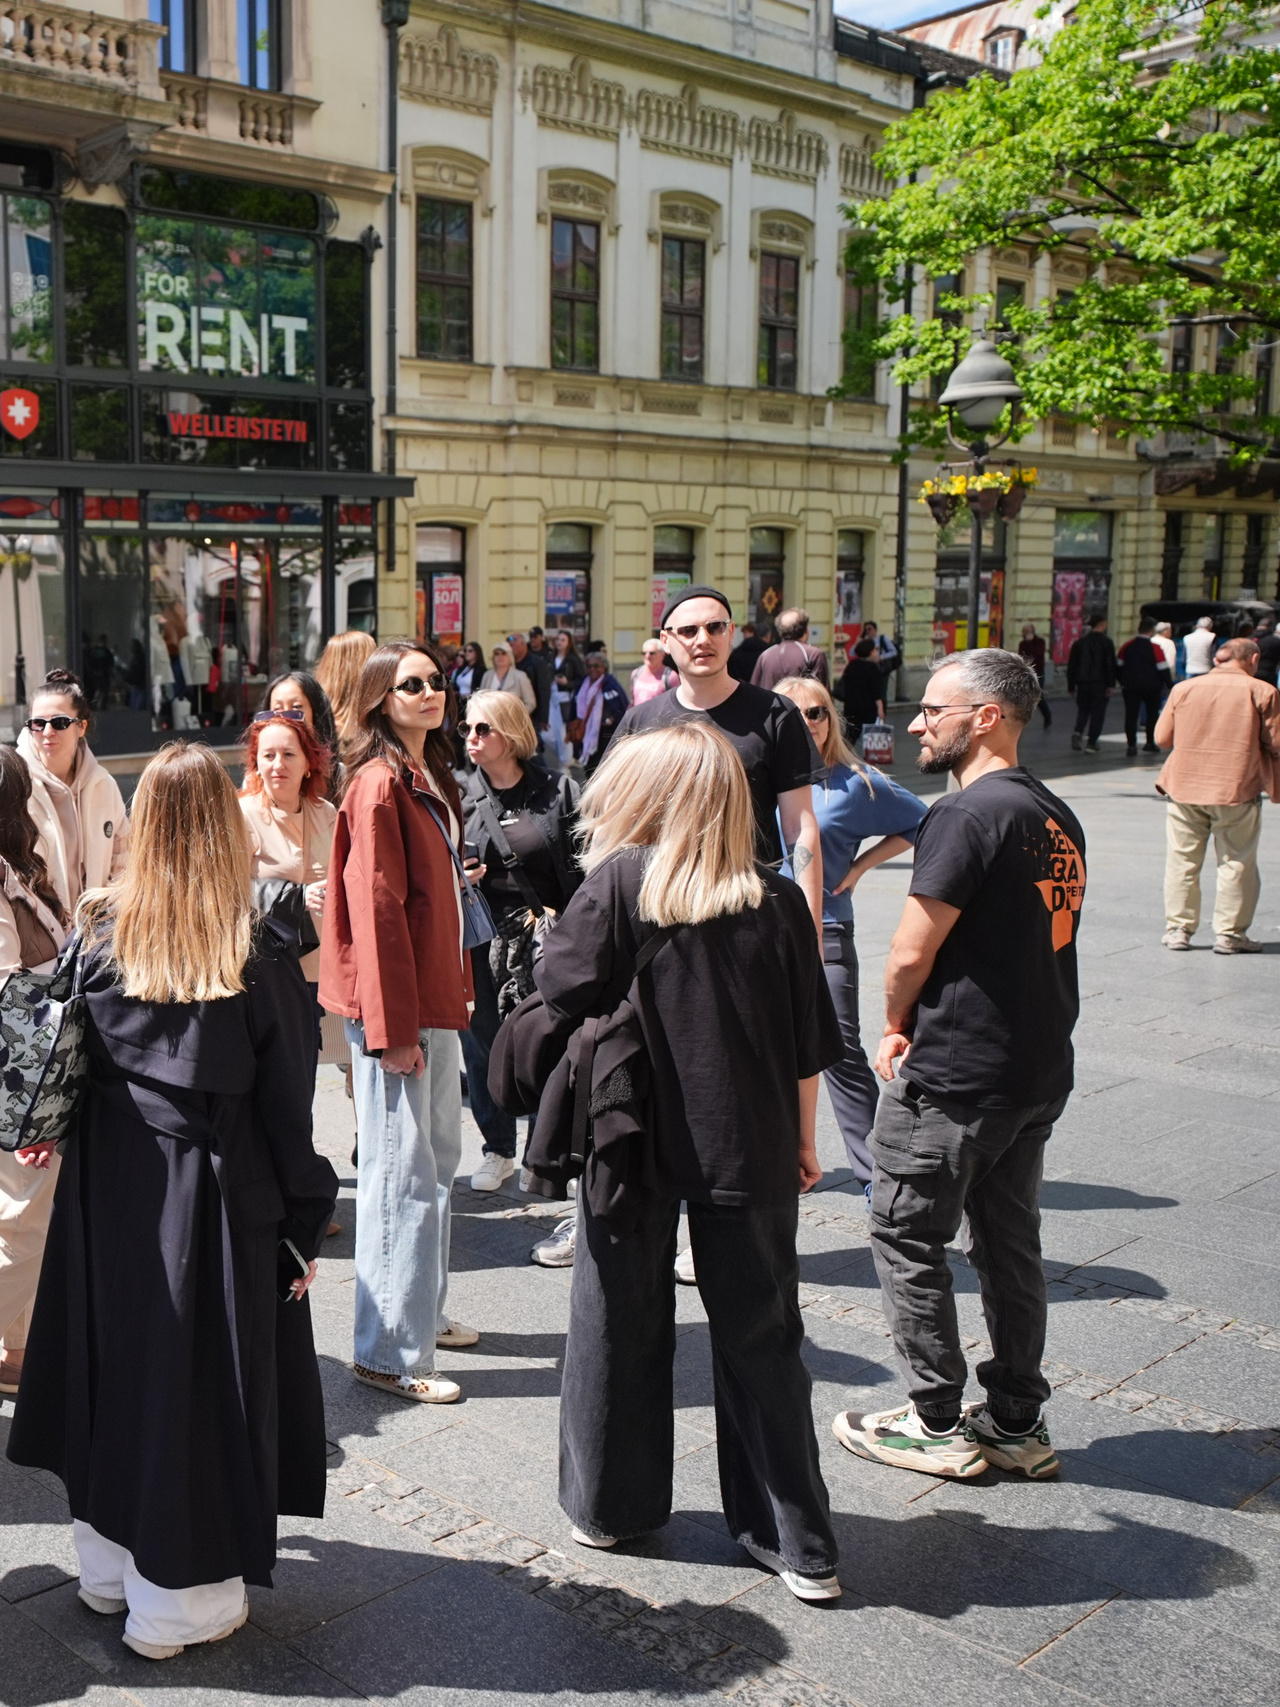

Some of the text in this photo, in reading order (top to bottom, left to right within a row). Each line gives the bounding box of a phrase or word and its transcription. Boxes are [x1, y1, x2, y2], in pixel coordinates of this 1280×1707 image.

[144, 271, 190, 297] FOR
[145, 300, 308, 377] RENT
[168, 411, 307, 443] WELLENSTEYN
